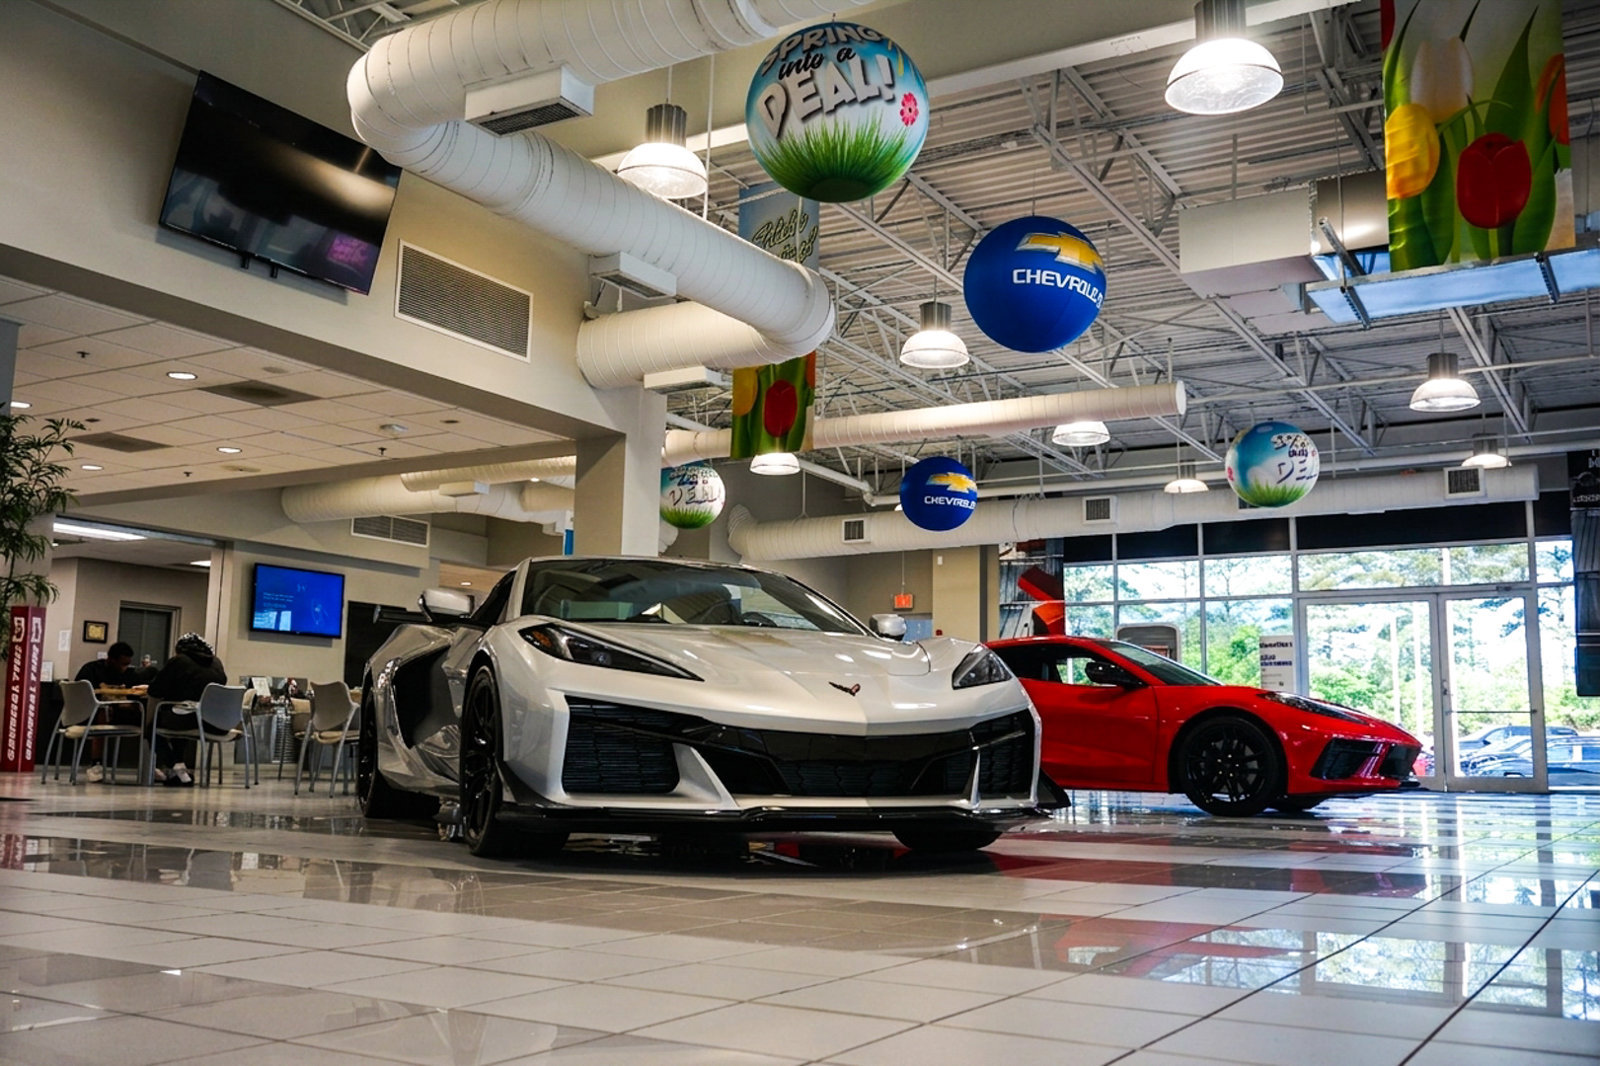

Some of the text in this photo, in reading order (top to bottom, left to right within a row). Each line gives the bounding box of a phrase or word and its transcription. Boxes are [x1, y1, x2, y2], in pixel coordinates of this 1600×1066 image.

[778, 47, 857, 80] into a
[757, 54, 896, 139] DEAL!
